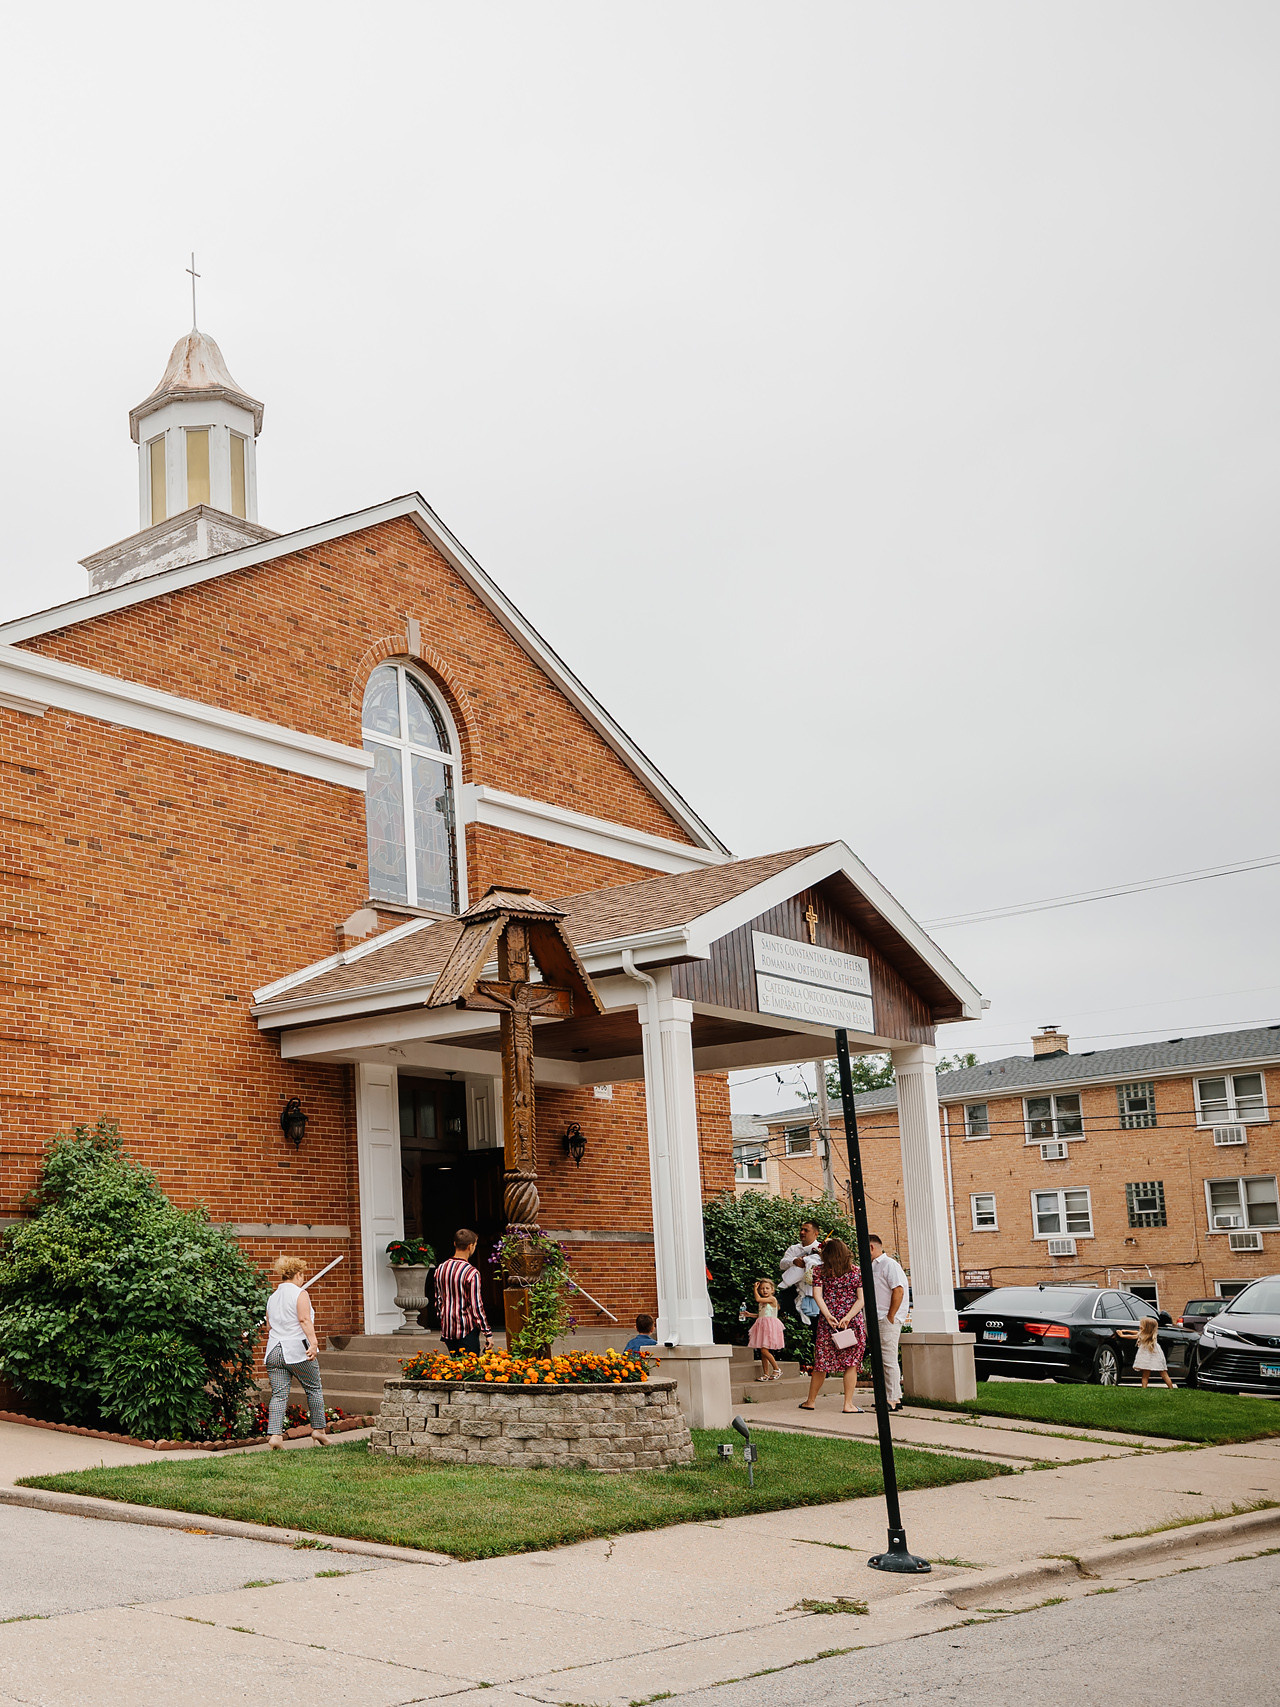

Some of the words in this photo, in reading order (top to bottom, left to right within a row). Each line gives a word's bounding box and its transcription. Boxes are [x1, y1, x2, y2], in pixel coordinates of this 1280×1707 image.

[761, 938, 783, 954] SAINTS
[784, 943, 828, 965] CONSTANTINE
[829, 955, 843, 968] AND
[843, 958, 863, 972] HELEN
[761, 954, 796, 972] ROMANIAN
[797, 962, 833, 981] ORTHODOX
[833, 971, 867, 989] CATHEDRAL
[803, 1001, 845, 1021] CONSTANTIN
[852, 1012, 872, 1026] ELENA
